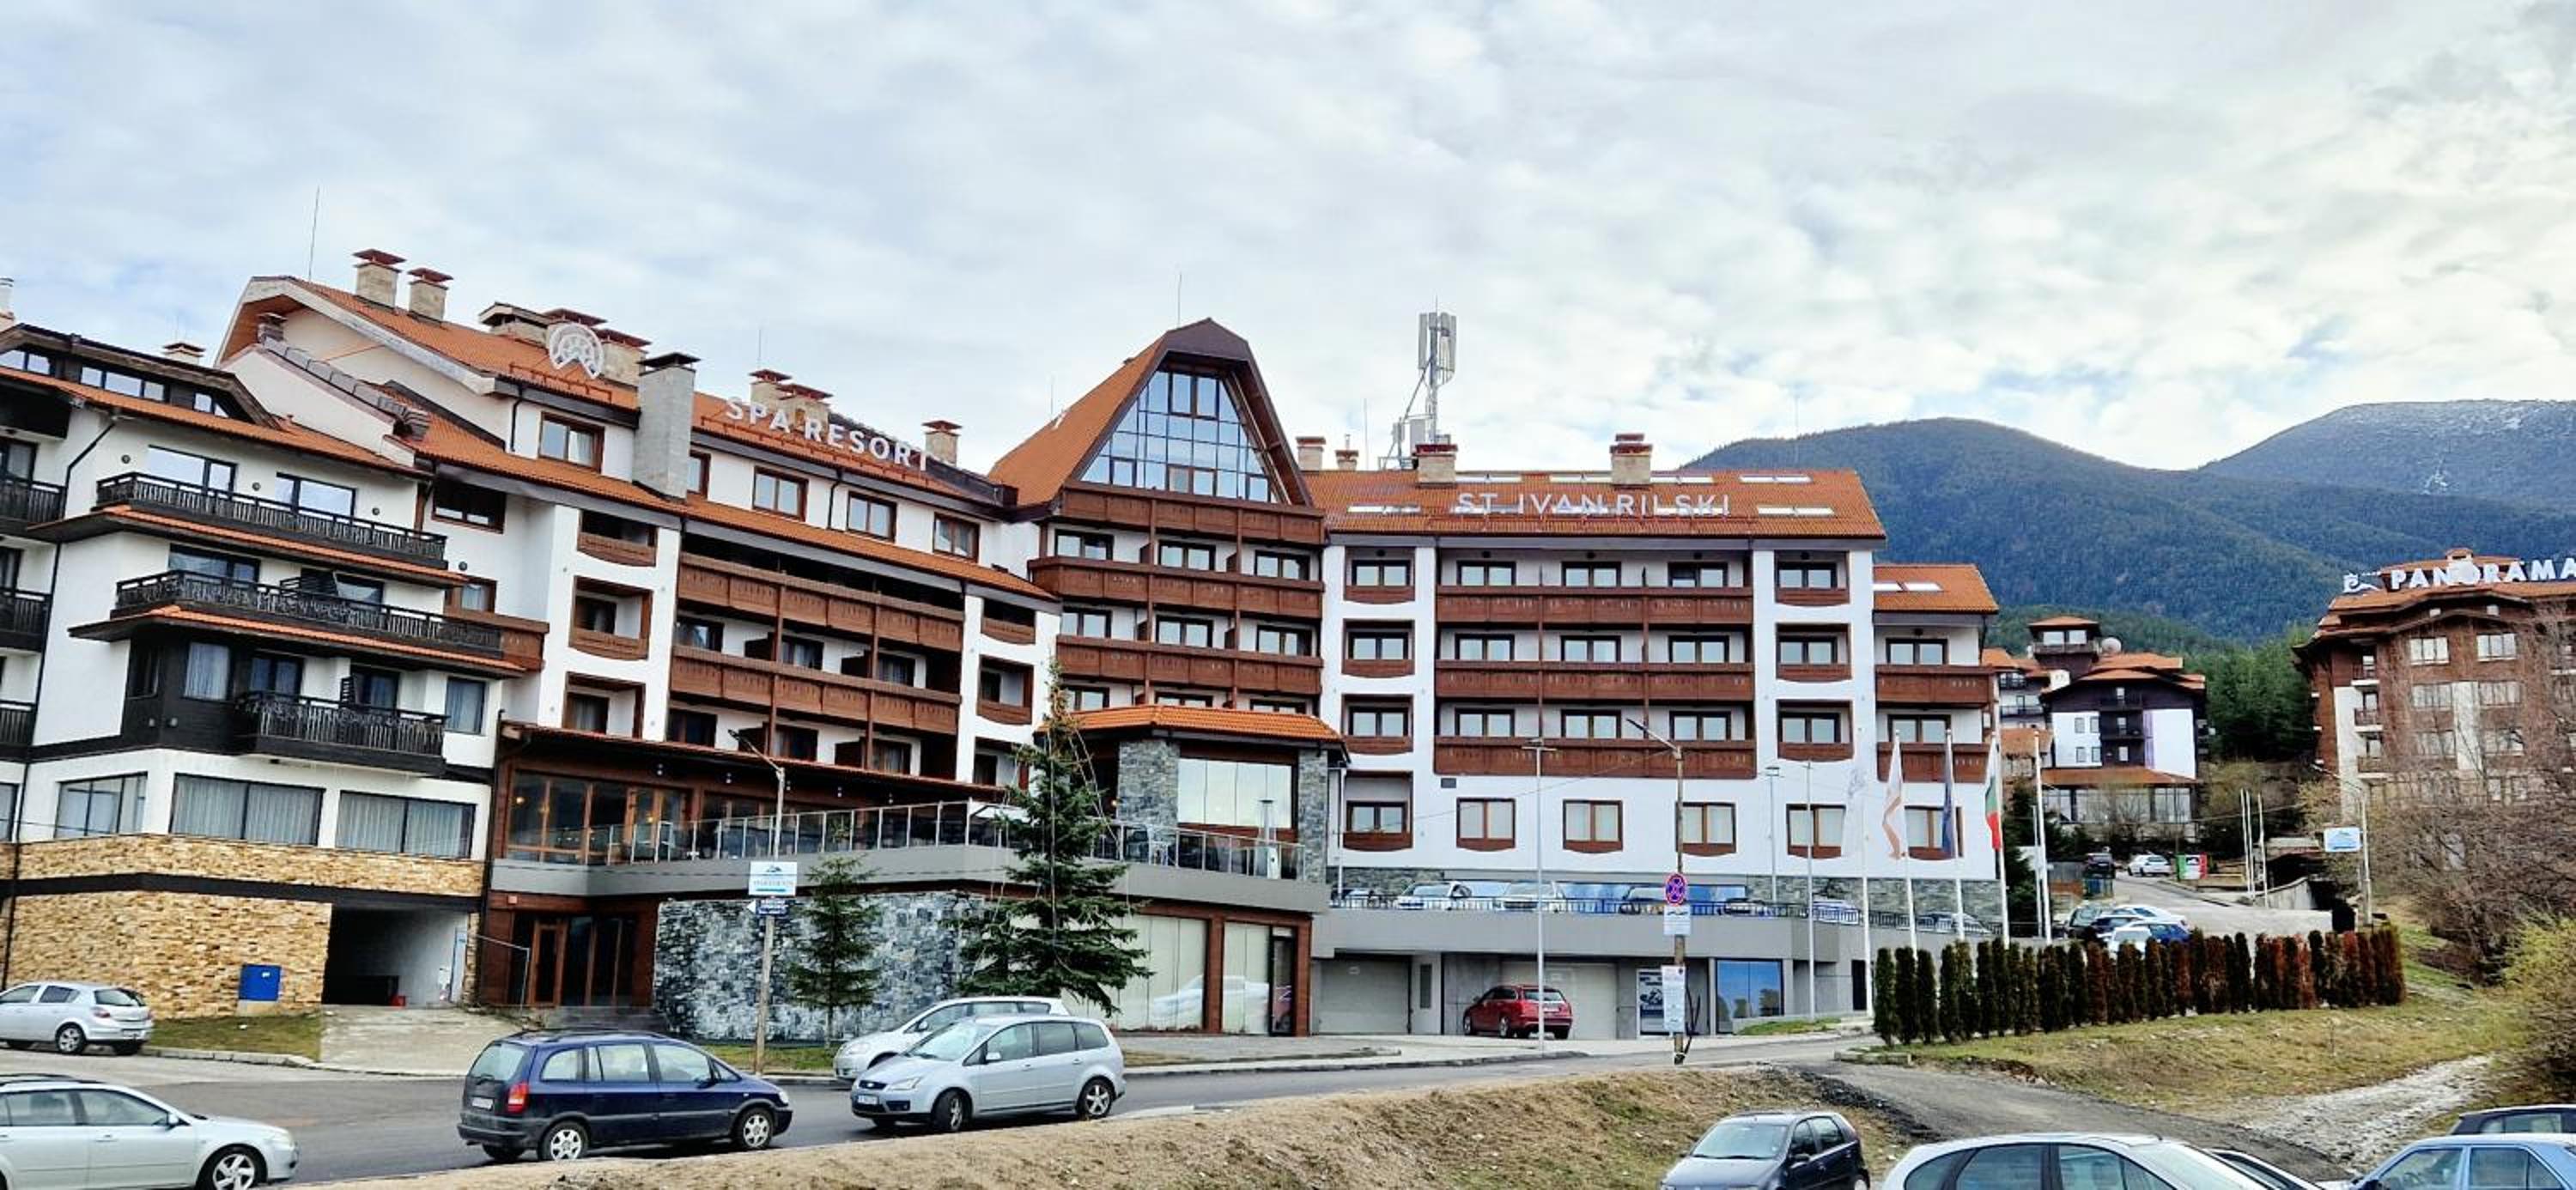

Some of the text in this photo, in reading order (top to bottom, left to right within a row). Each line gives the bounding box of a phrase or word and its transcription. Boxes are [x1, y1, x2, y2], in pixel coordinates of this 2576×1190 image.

[726, 396, 941, 471] SPA RESORT
[1518, 493, 1606, 516] IVAN
[1616, 493, 1731, 517] RILSKI
[2391, 557, 2576, 590] PANORAMA
